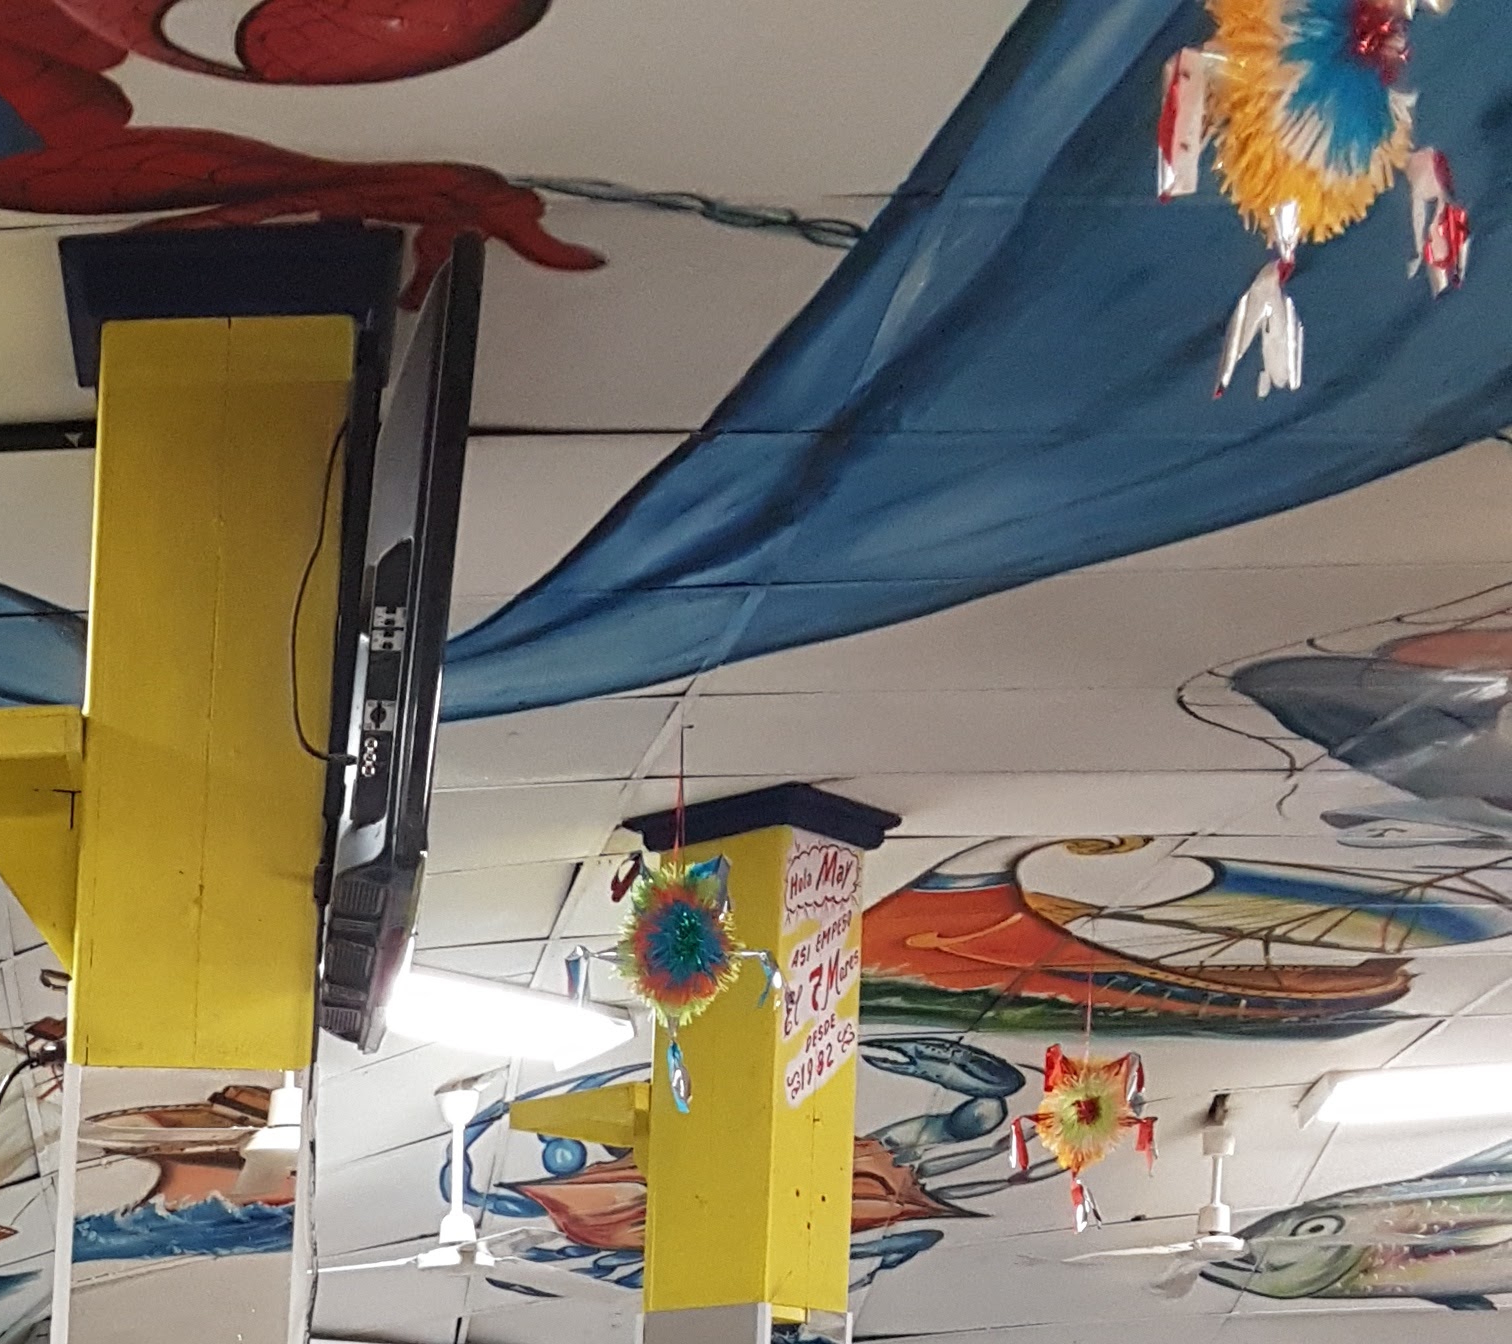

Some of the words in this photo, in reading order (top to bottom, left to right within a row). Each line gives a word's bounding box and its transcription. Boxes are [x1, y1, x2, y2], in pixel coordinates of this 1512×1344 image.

[790, 867, 812, 899] Hola
[815, 851, 853, 891] May
[791, 944, 810, 968] ASI
[816, 909, 852, 952] EMPESO
[809, 963, 823, 1011] 7
[821, 948, 858, 1011] Mares
[805, 1013, 836, 1053] DESDE
[801, 1042, 834, 1090] 1982
